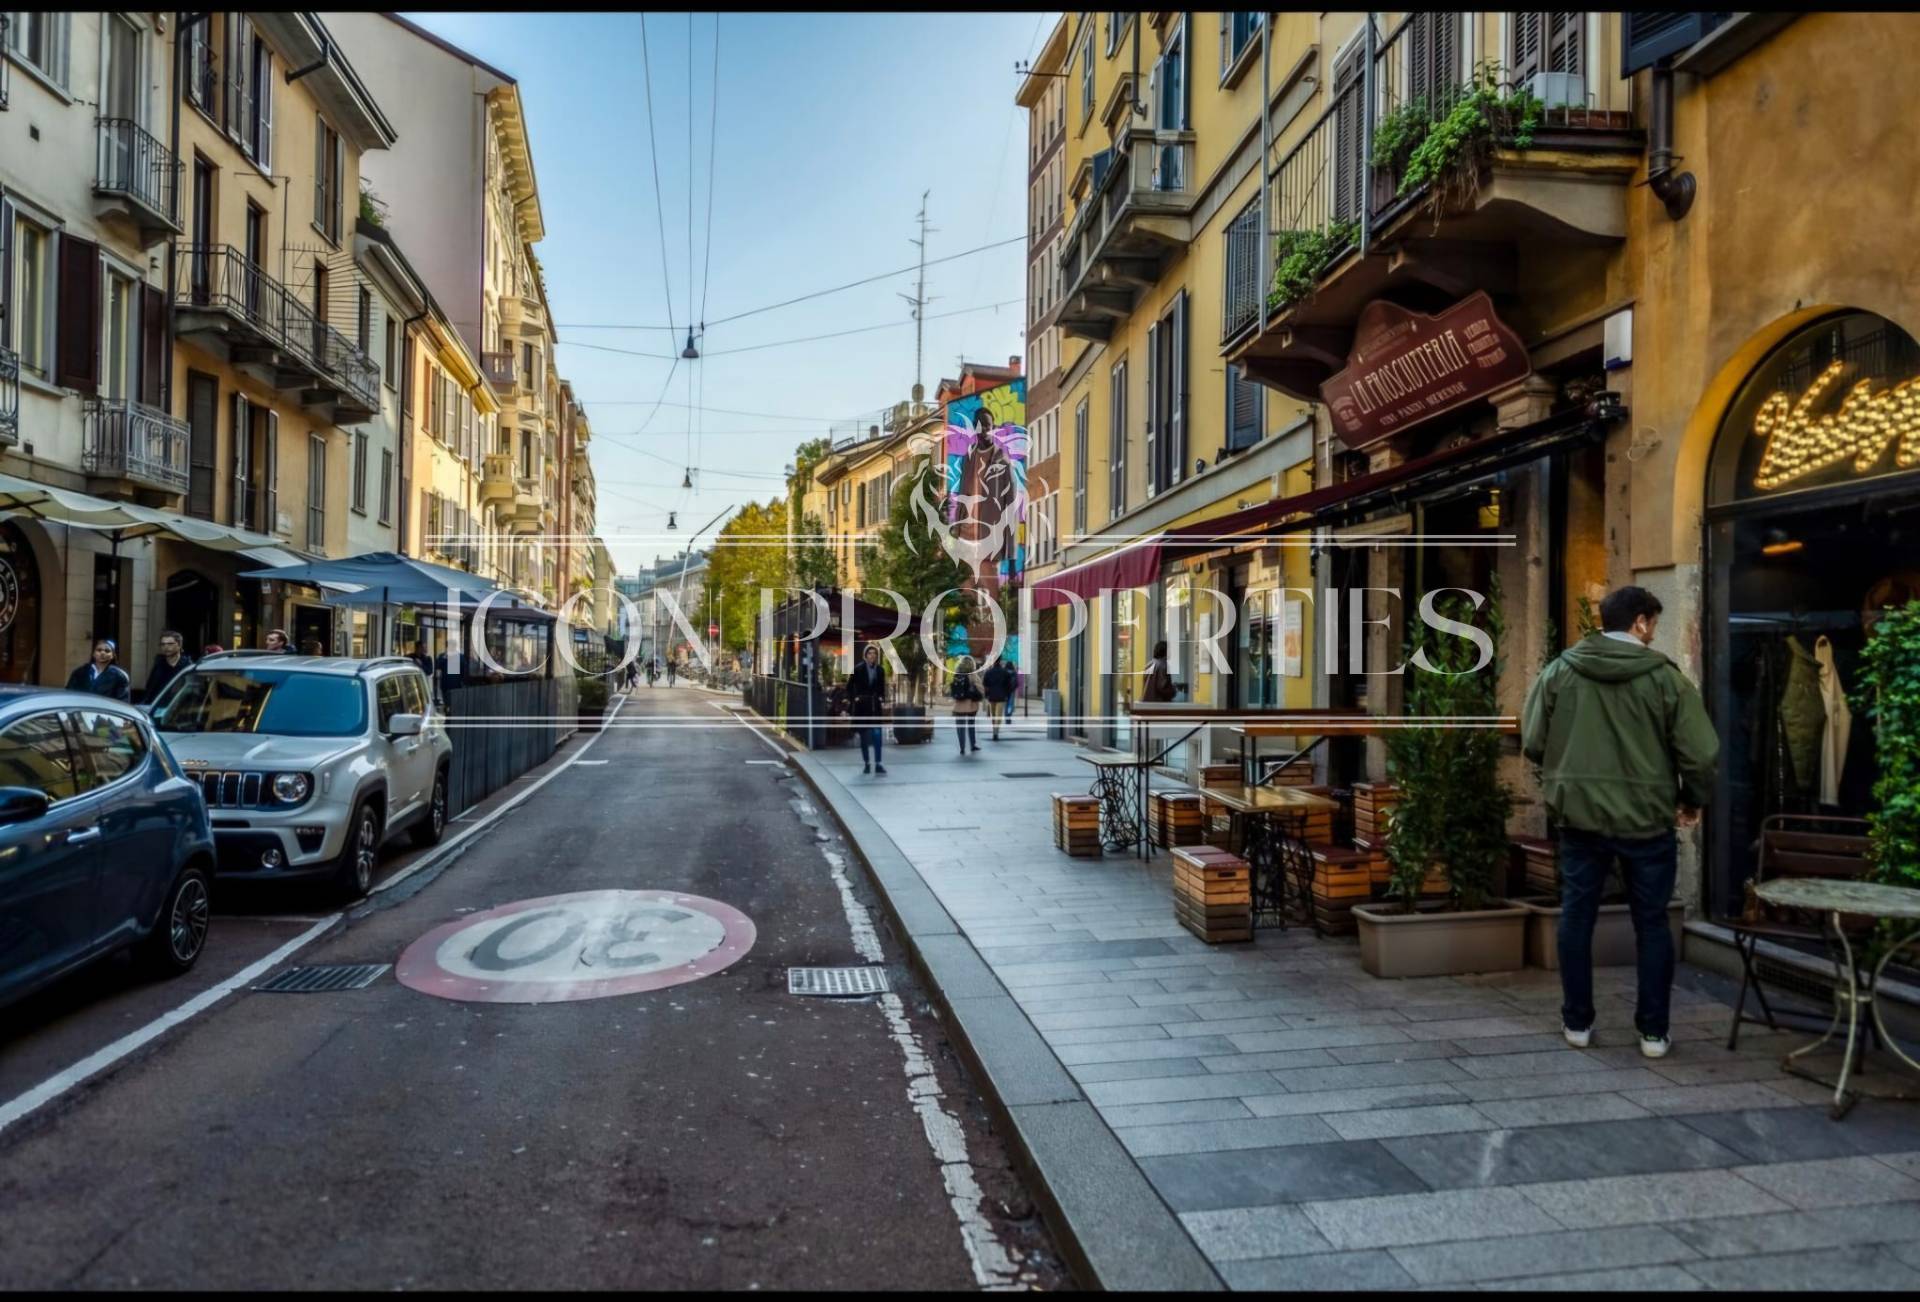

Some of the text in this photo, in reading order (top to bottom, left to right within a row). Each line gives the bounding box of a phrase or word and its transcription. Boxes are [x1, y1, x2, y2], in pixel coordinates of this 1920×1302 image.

[1349, 380, 1377, 415] LA
[1364, 329, 1469, 407] PROSCIUTTERIA
[470, 906, 693, 972] 30
